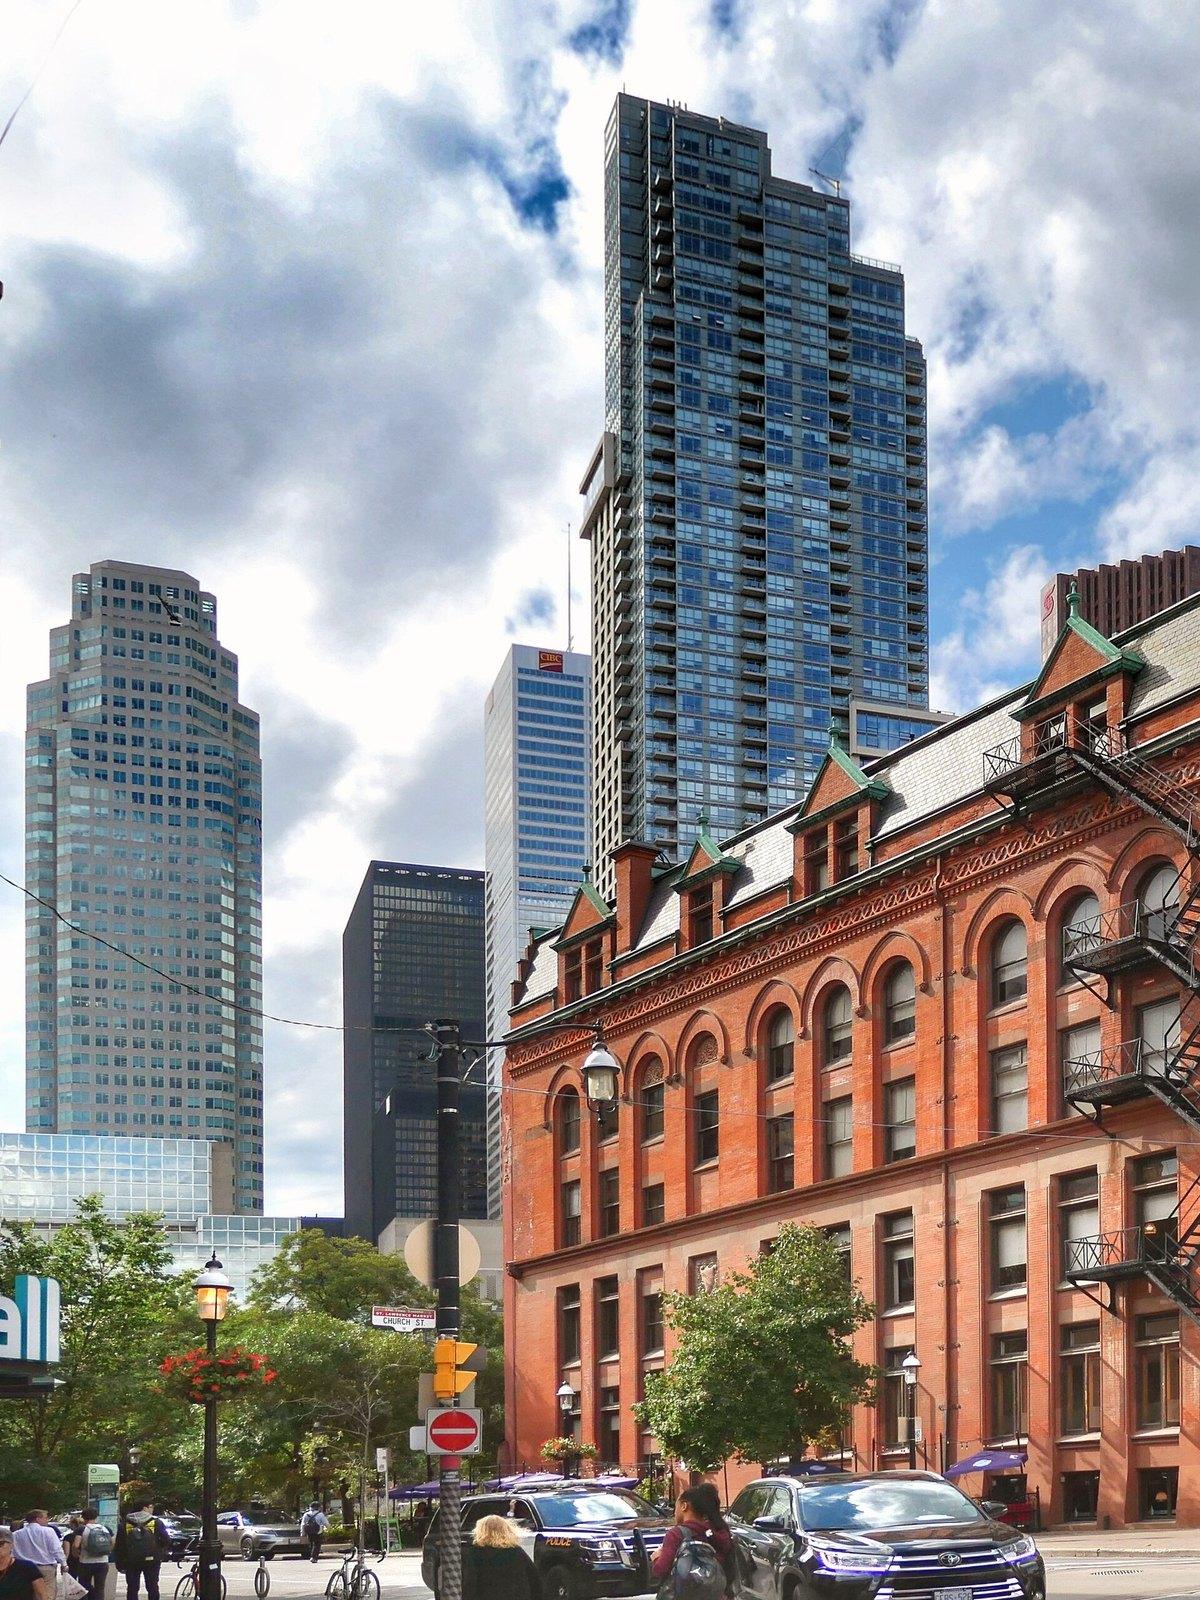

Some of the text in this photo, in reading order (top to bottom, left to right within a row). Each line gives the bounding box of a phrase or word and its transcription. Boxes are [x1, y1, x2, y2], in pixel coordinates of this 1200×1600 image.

[540, 652, 562, 663] CIBC
[383, 1317, 426, 1327] CHURCH ST.
[545, 1536, 572, 1546] POLICE
